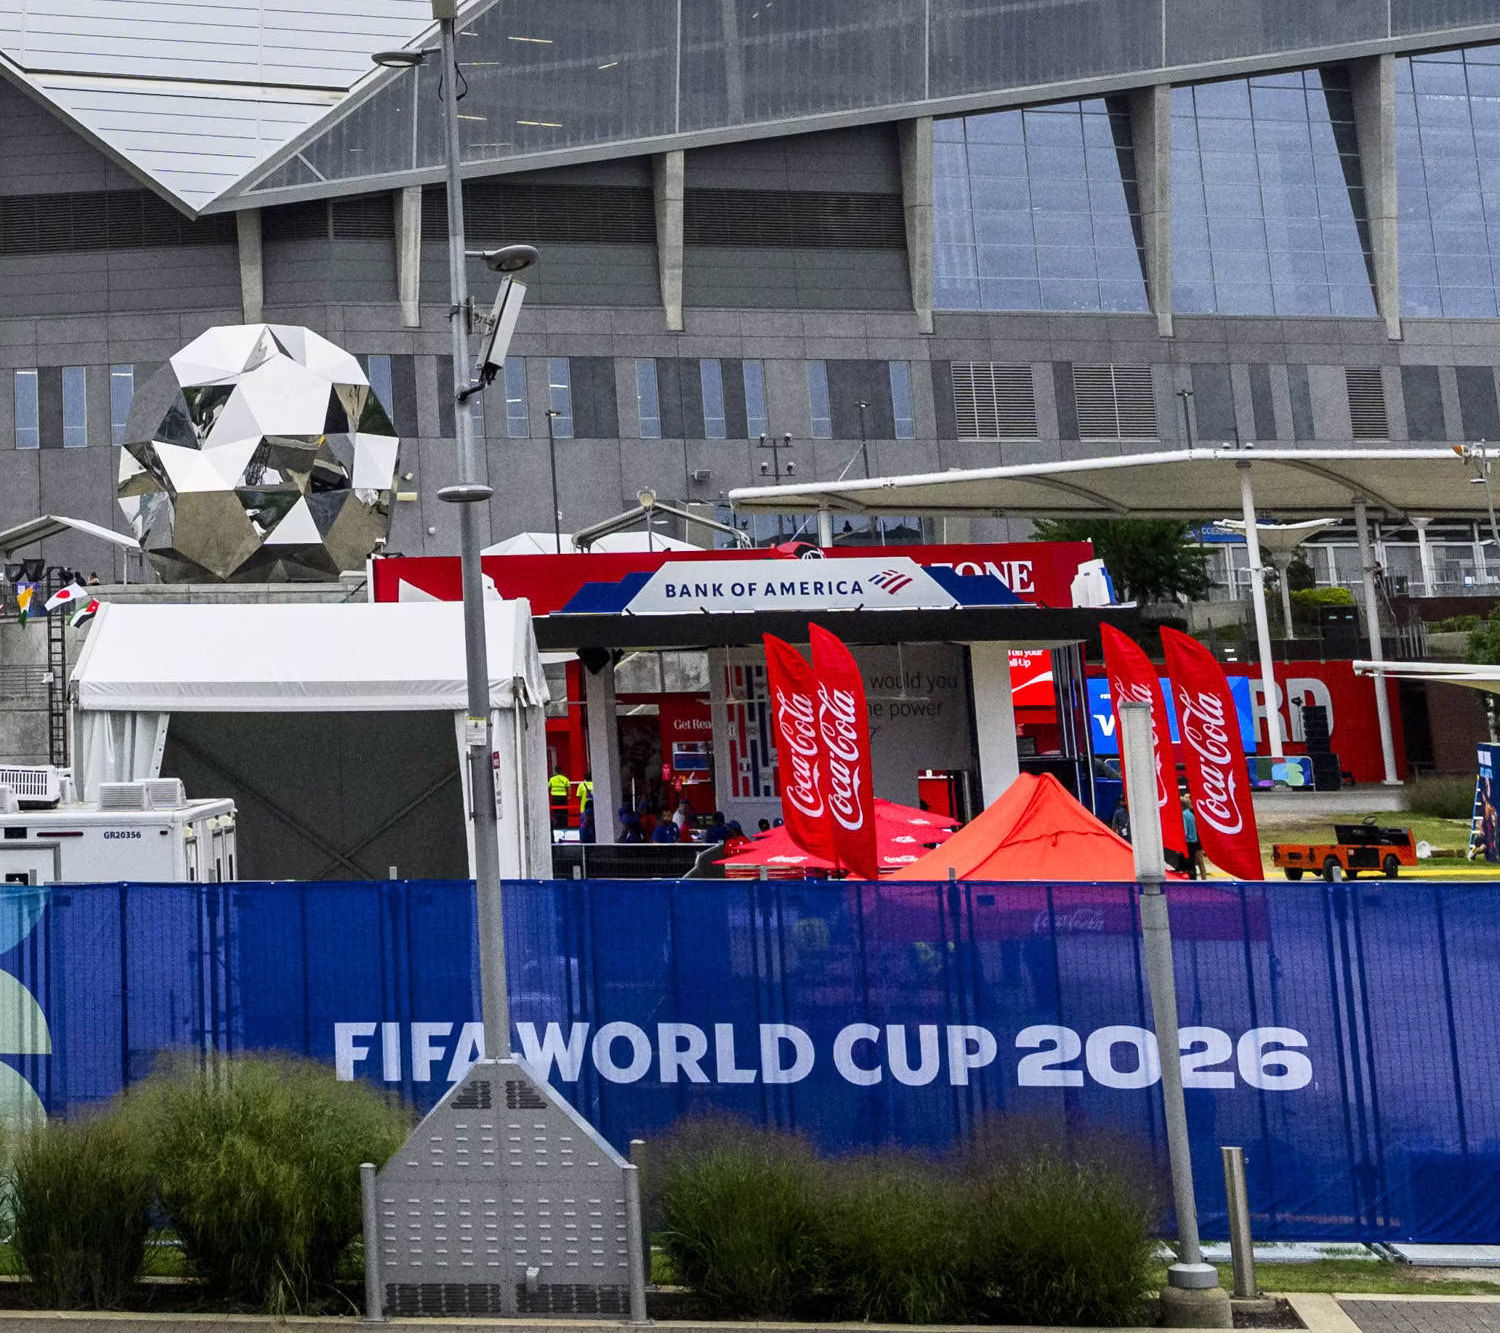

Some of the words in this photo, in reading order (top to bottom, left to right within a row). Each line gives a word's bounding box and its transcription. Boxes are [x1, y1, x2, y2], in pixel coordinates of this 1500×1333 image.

[665, 582, 724, 599] BANK
[730, 582, 758, 598] OF
[763, 580, 864, 597] AMERICA
[871, 673, 921, 689] would
[926, 676, 956, 693] you
[889, 701, 944, 719] power
[673, 719, 694, 730] Get
[776, 684, 824, 818] Coca-Cola
[817, 680, 864, 831] Coca-Cola
[1179, 684, 1243, 835] Coca-Cola
[103, 831, 142, 839] GR20356
[512, 1022, 817, 1086] WORLD
[832, 1022, 997, 1087] CUP
[1016, 1024, 1312, 1090] 2026
